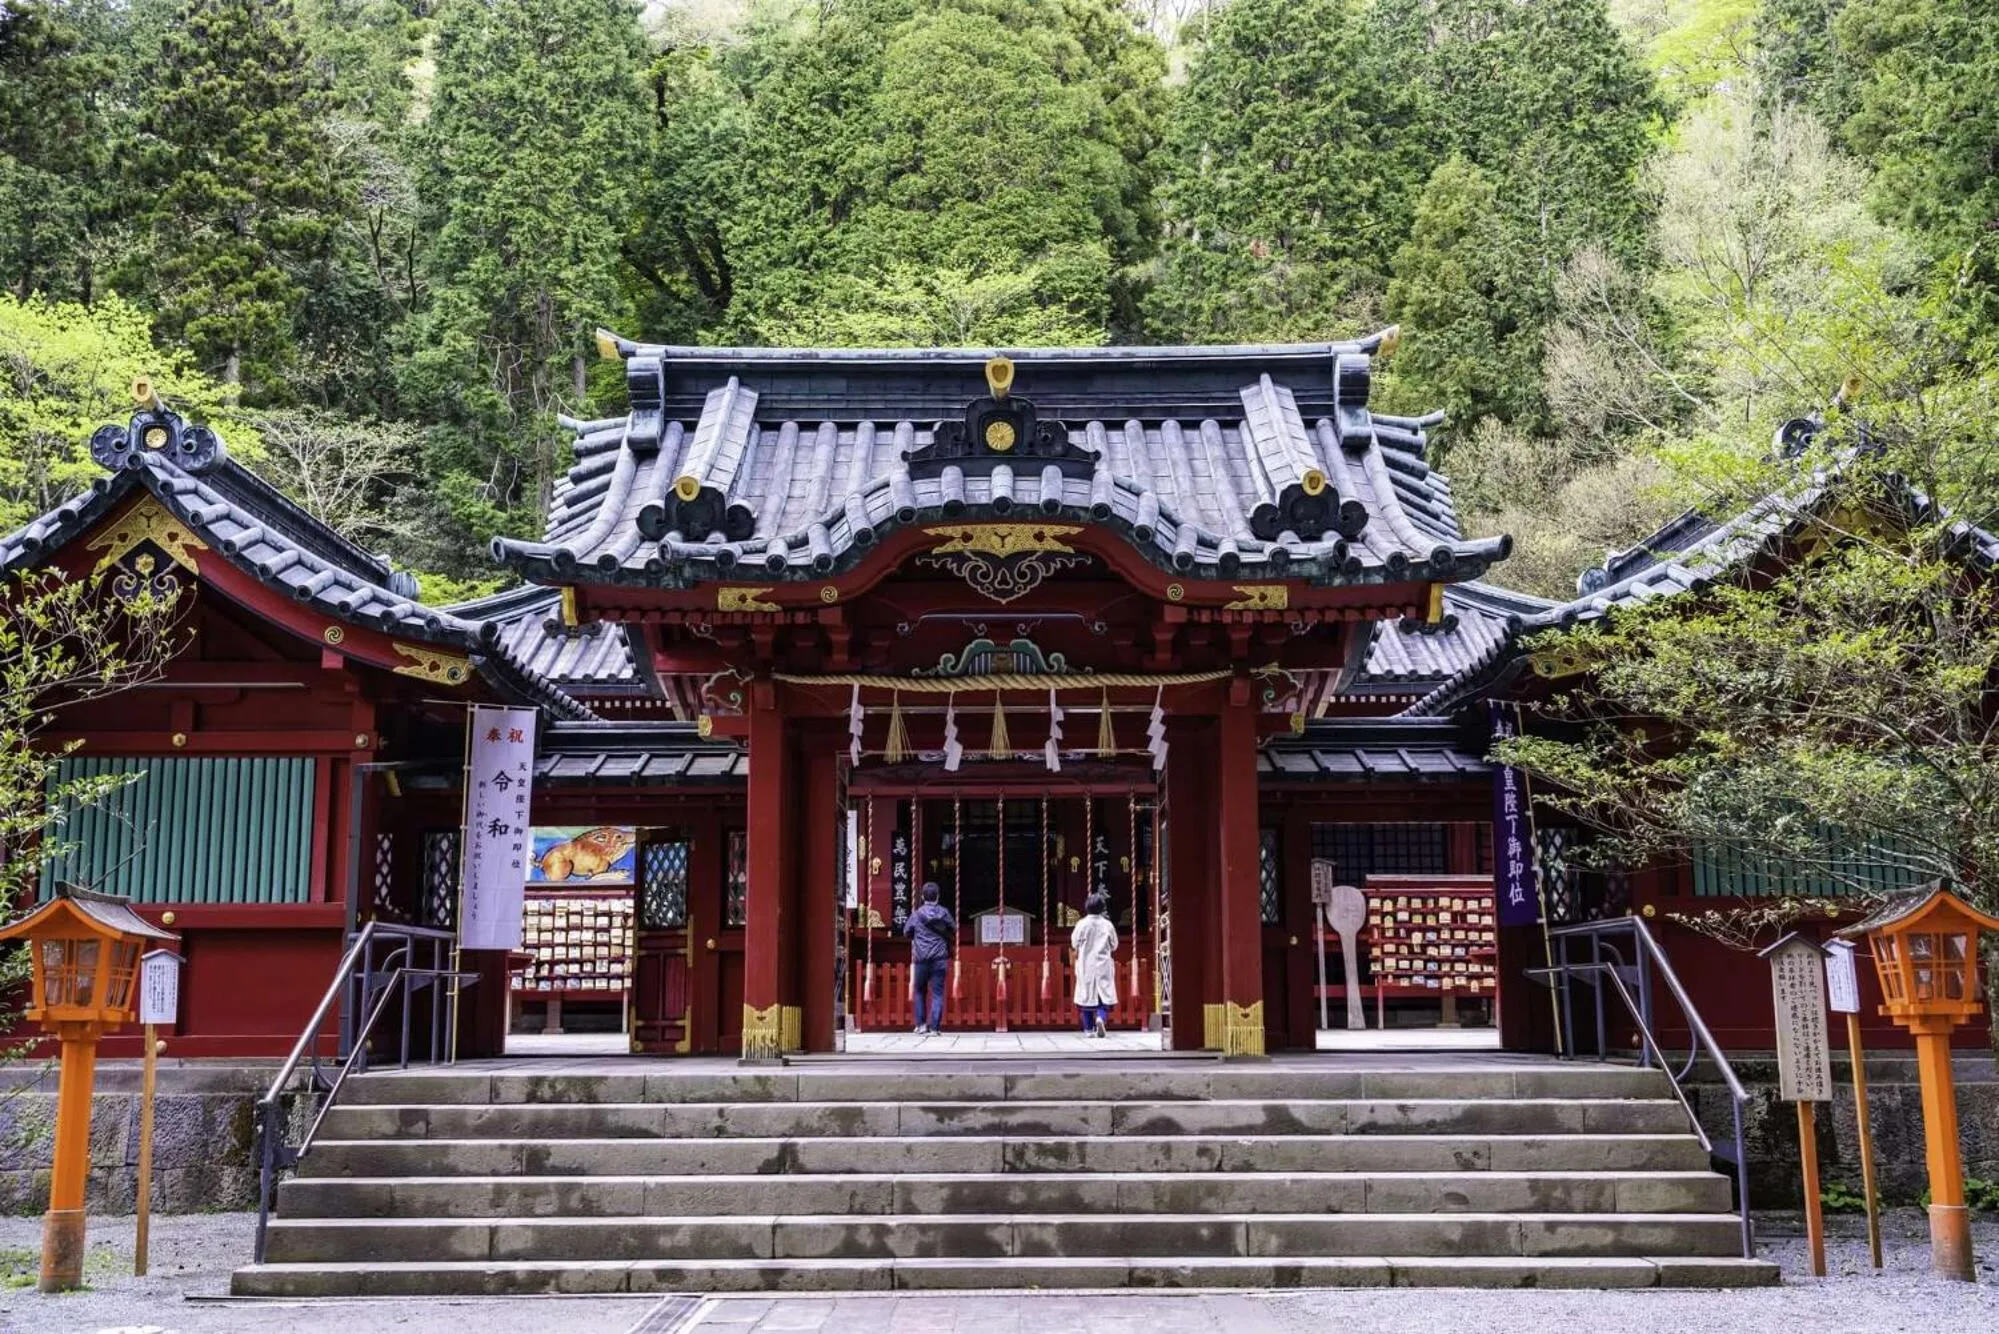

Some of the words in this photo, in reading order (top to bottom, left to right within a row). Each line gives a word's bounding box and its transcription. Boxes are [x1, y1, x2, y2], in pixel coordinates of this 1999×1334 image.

[484, 728, 525, 744] 奉祝
[488, 770, 514, 838] 令和
[510, 761, 528, 870] 天皇陛下御即位
[1503, 768, 1526, 906] 皇陛下御即位
